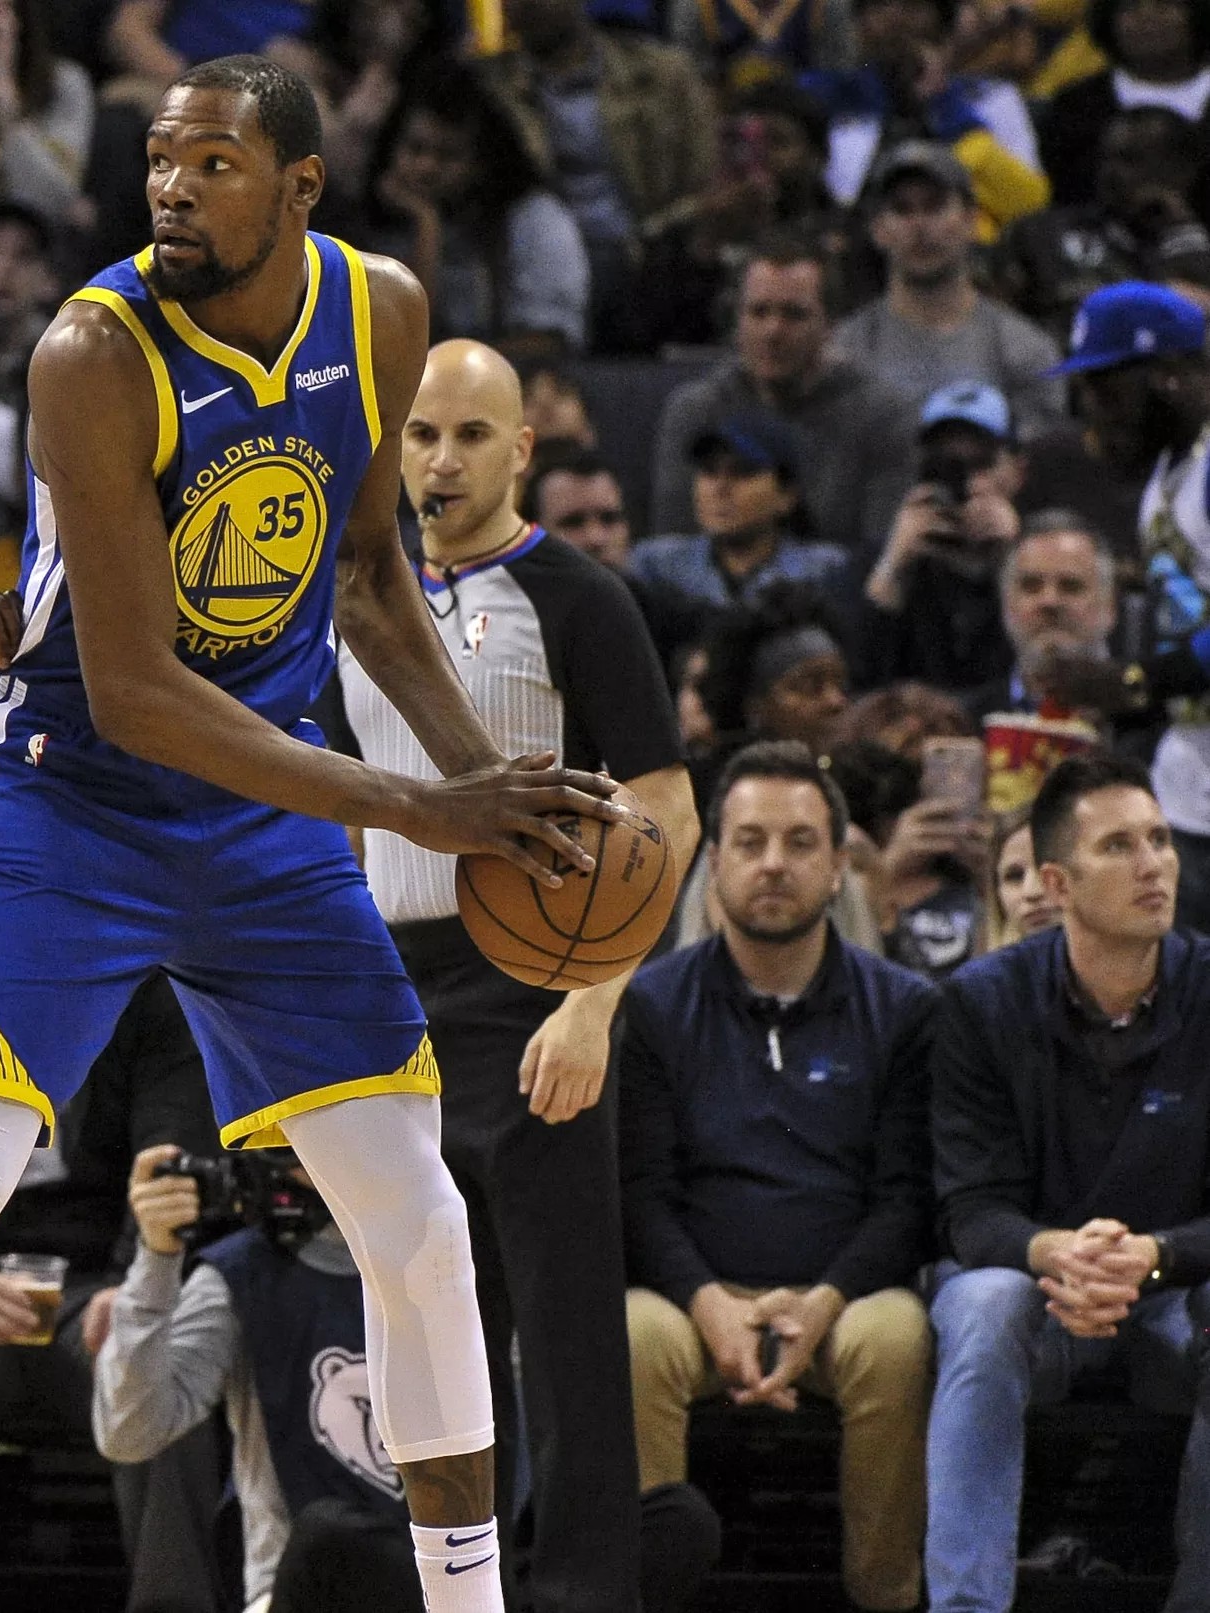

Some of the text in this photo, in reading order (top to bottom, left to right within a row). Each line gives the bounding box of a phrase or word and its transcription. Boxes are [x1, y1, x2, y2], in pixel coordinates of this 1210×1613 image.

[295, 364, 350, 390] Rakuten
[183, 436, 335, 505] GOLDEN STATE
[254, 490, 307, 542] 35
